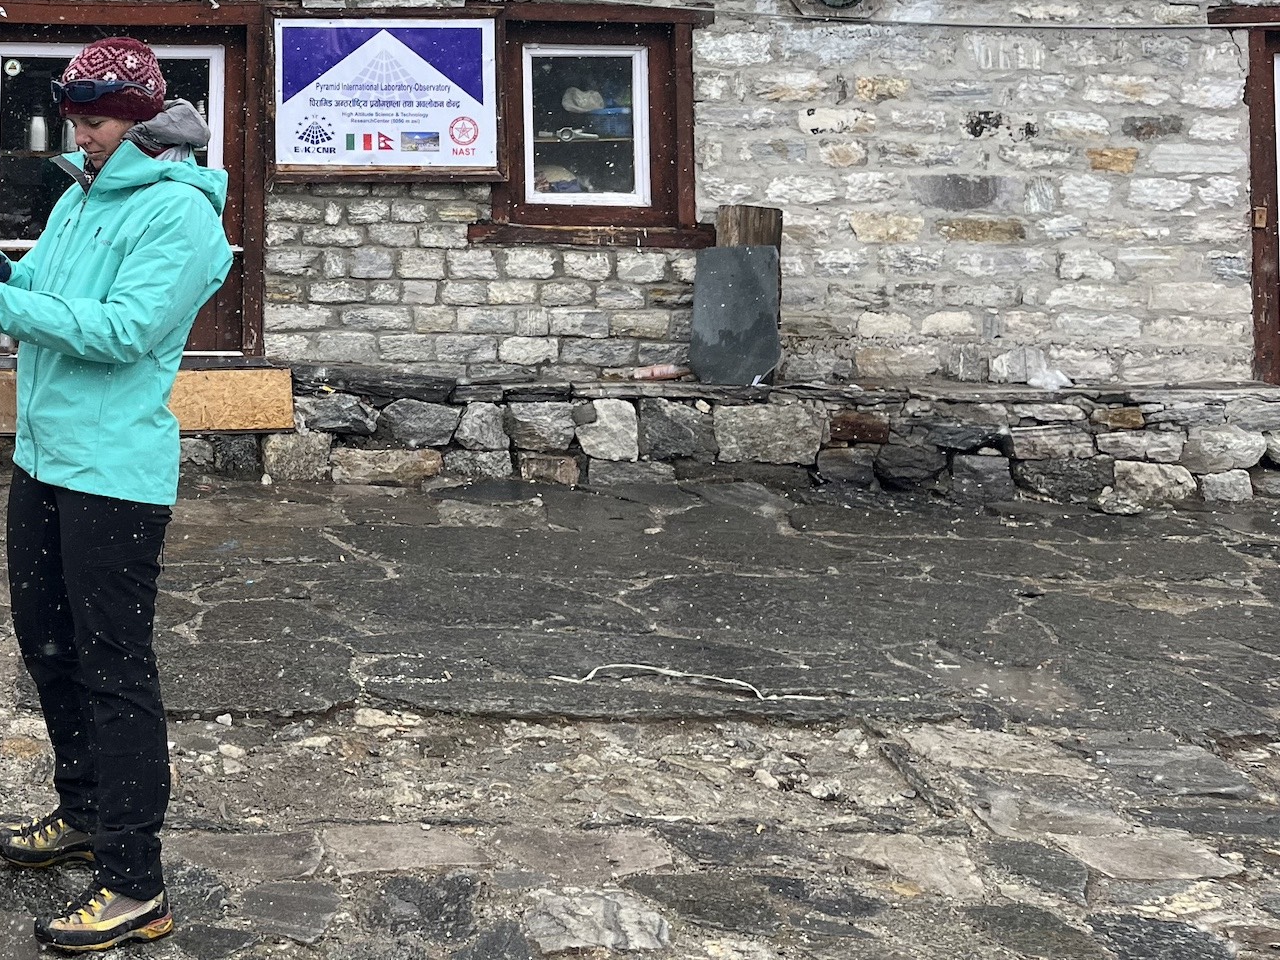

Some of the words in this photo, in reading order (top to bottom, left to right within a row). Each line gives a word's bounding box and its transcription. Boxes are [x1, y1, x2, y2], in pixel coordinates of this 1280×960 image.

[315, 82, 340, 92] Pyramid
[341, 82, 379, 91] International
[309, 97, 333, 107] पिरामिड
[402, 100, 414, 108] तथा
[415, 98, 445, 108] अवलोकन
[452, 148, 477, 156] NAST
